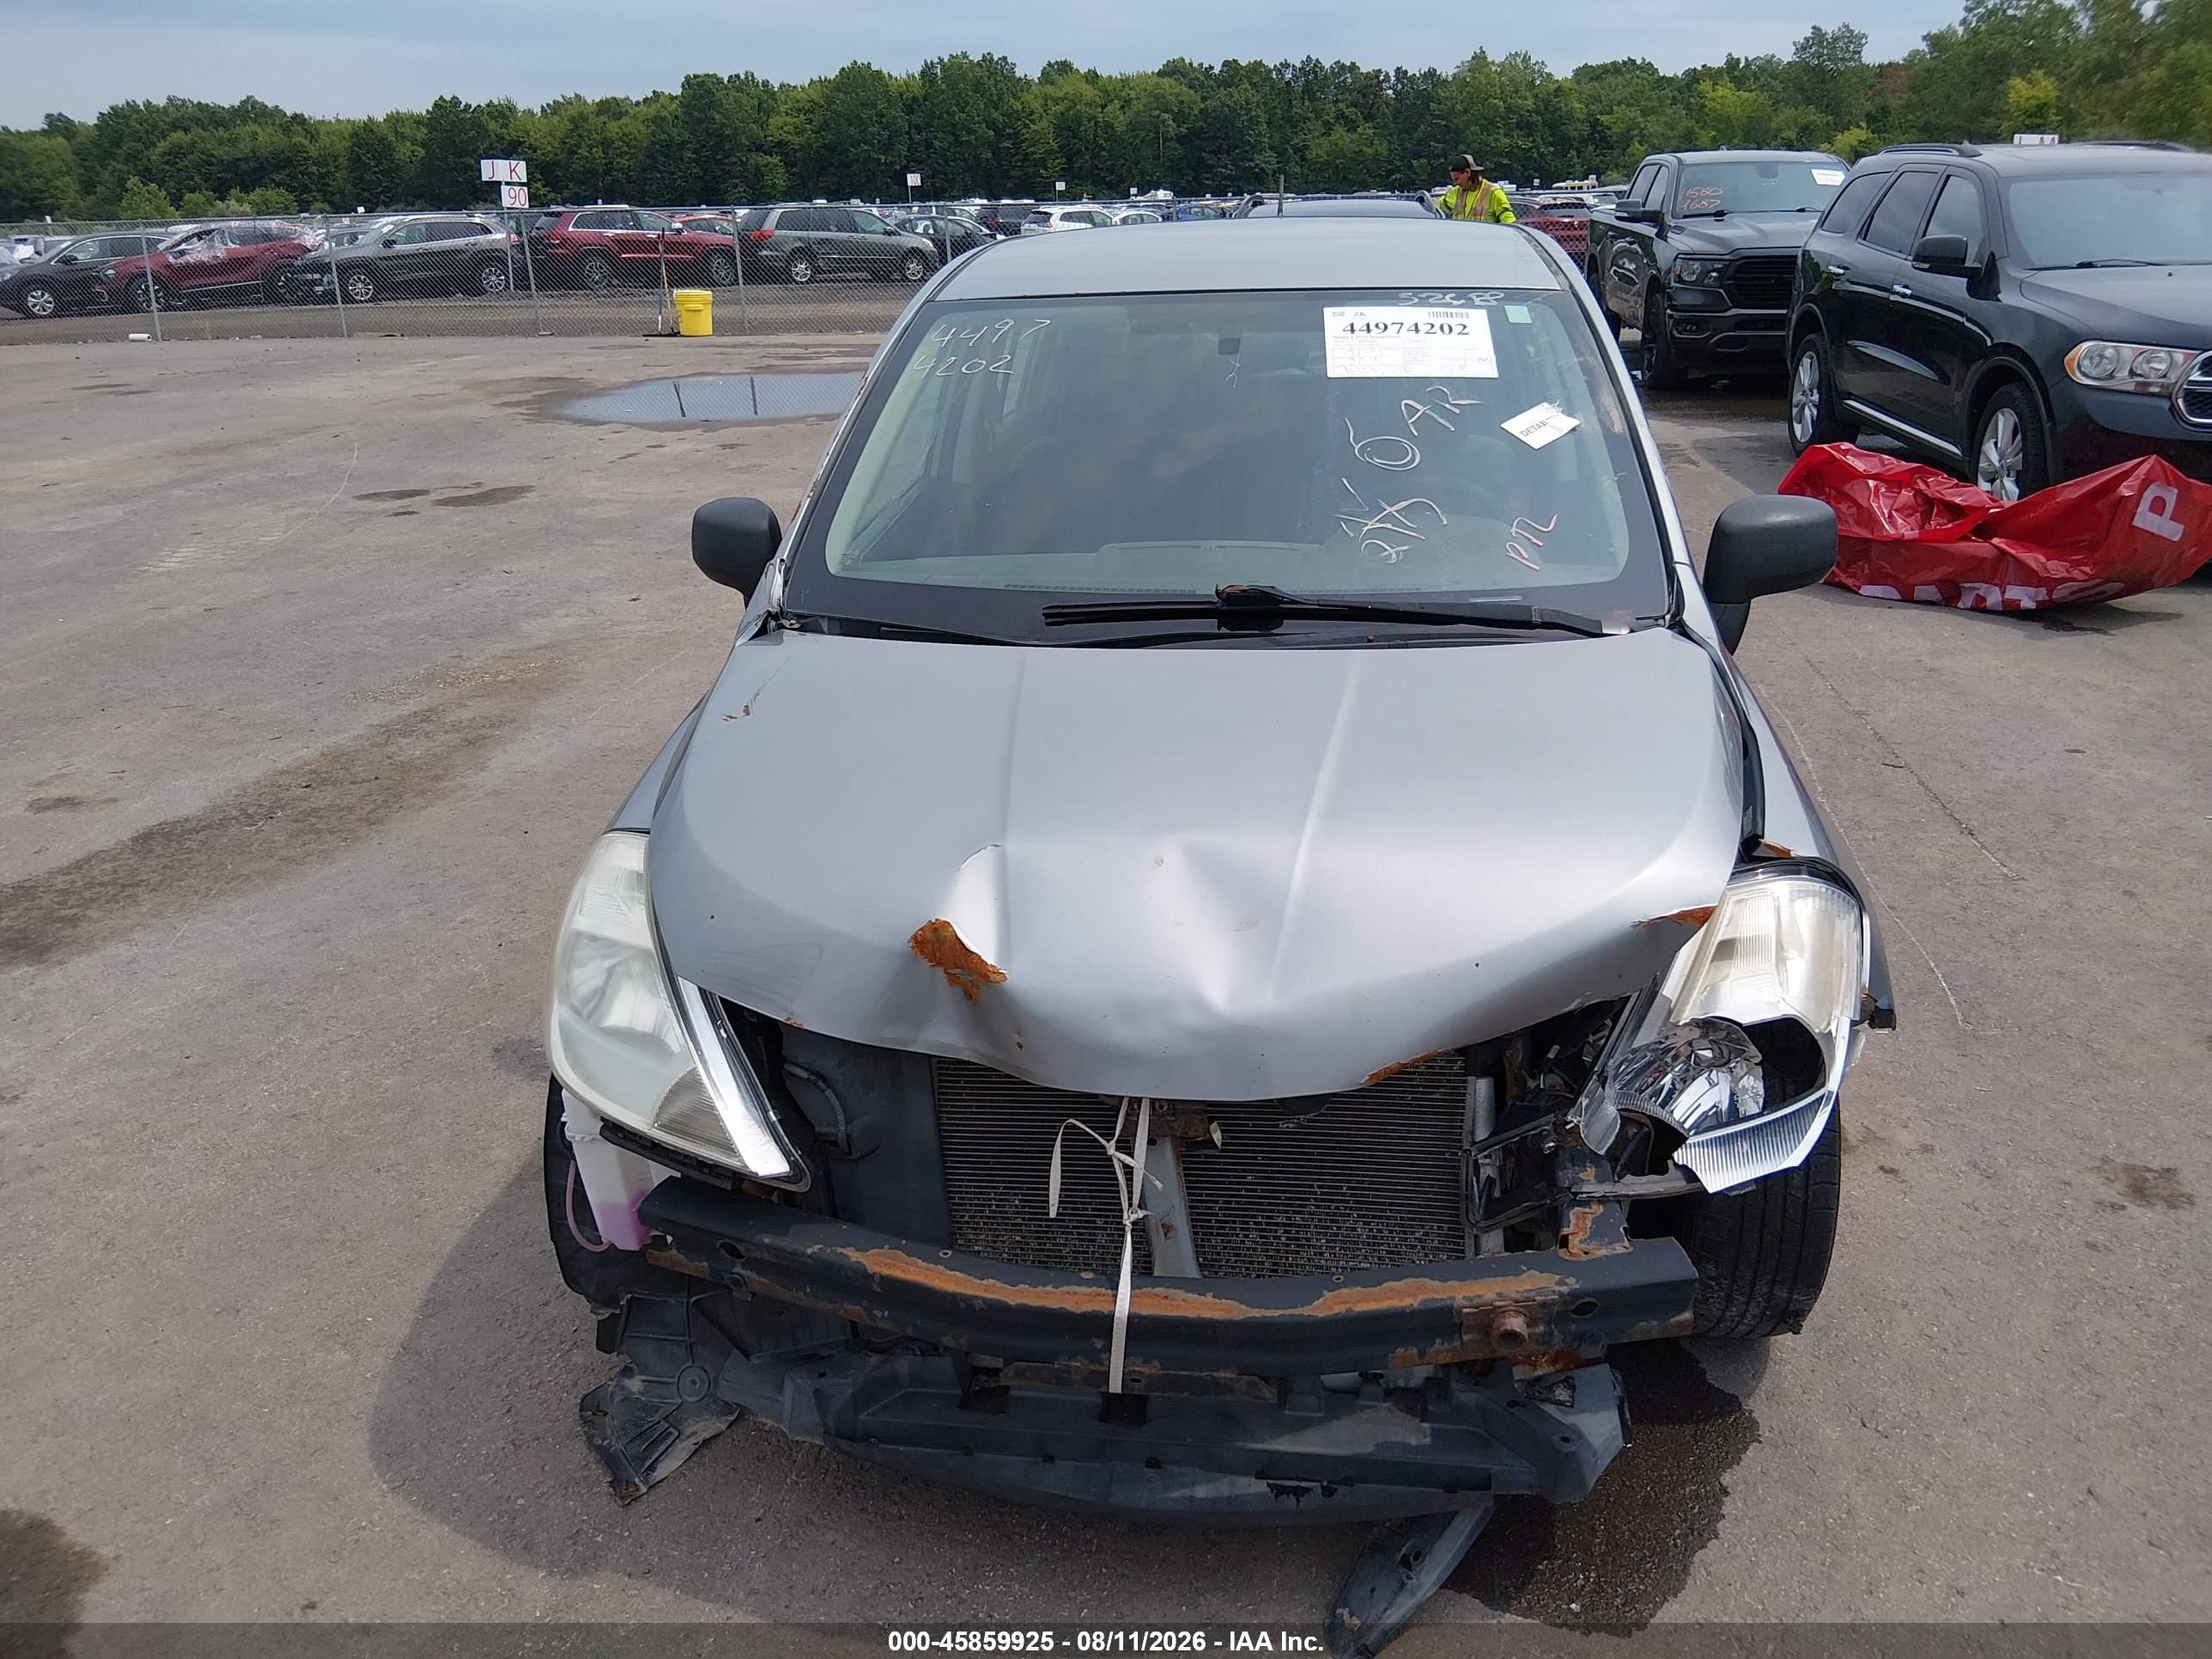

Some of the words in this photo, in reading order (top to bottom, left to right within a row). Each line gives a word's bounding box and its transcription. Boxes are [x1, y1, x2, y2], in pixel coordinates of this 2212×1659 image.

[489, 161, 495, 179] J
[508, 161, 522, 180] K
[507, 187, 526, 206] 90
[933, 319, 1052, 348] 4497
[1342, 321, 1470, 336] 44974202
[913, 355, 1014, 378] 4202
[2131, 481, 2185, 542] P
